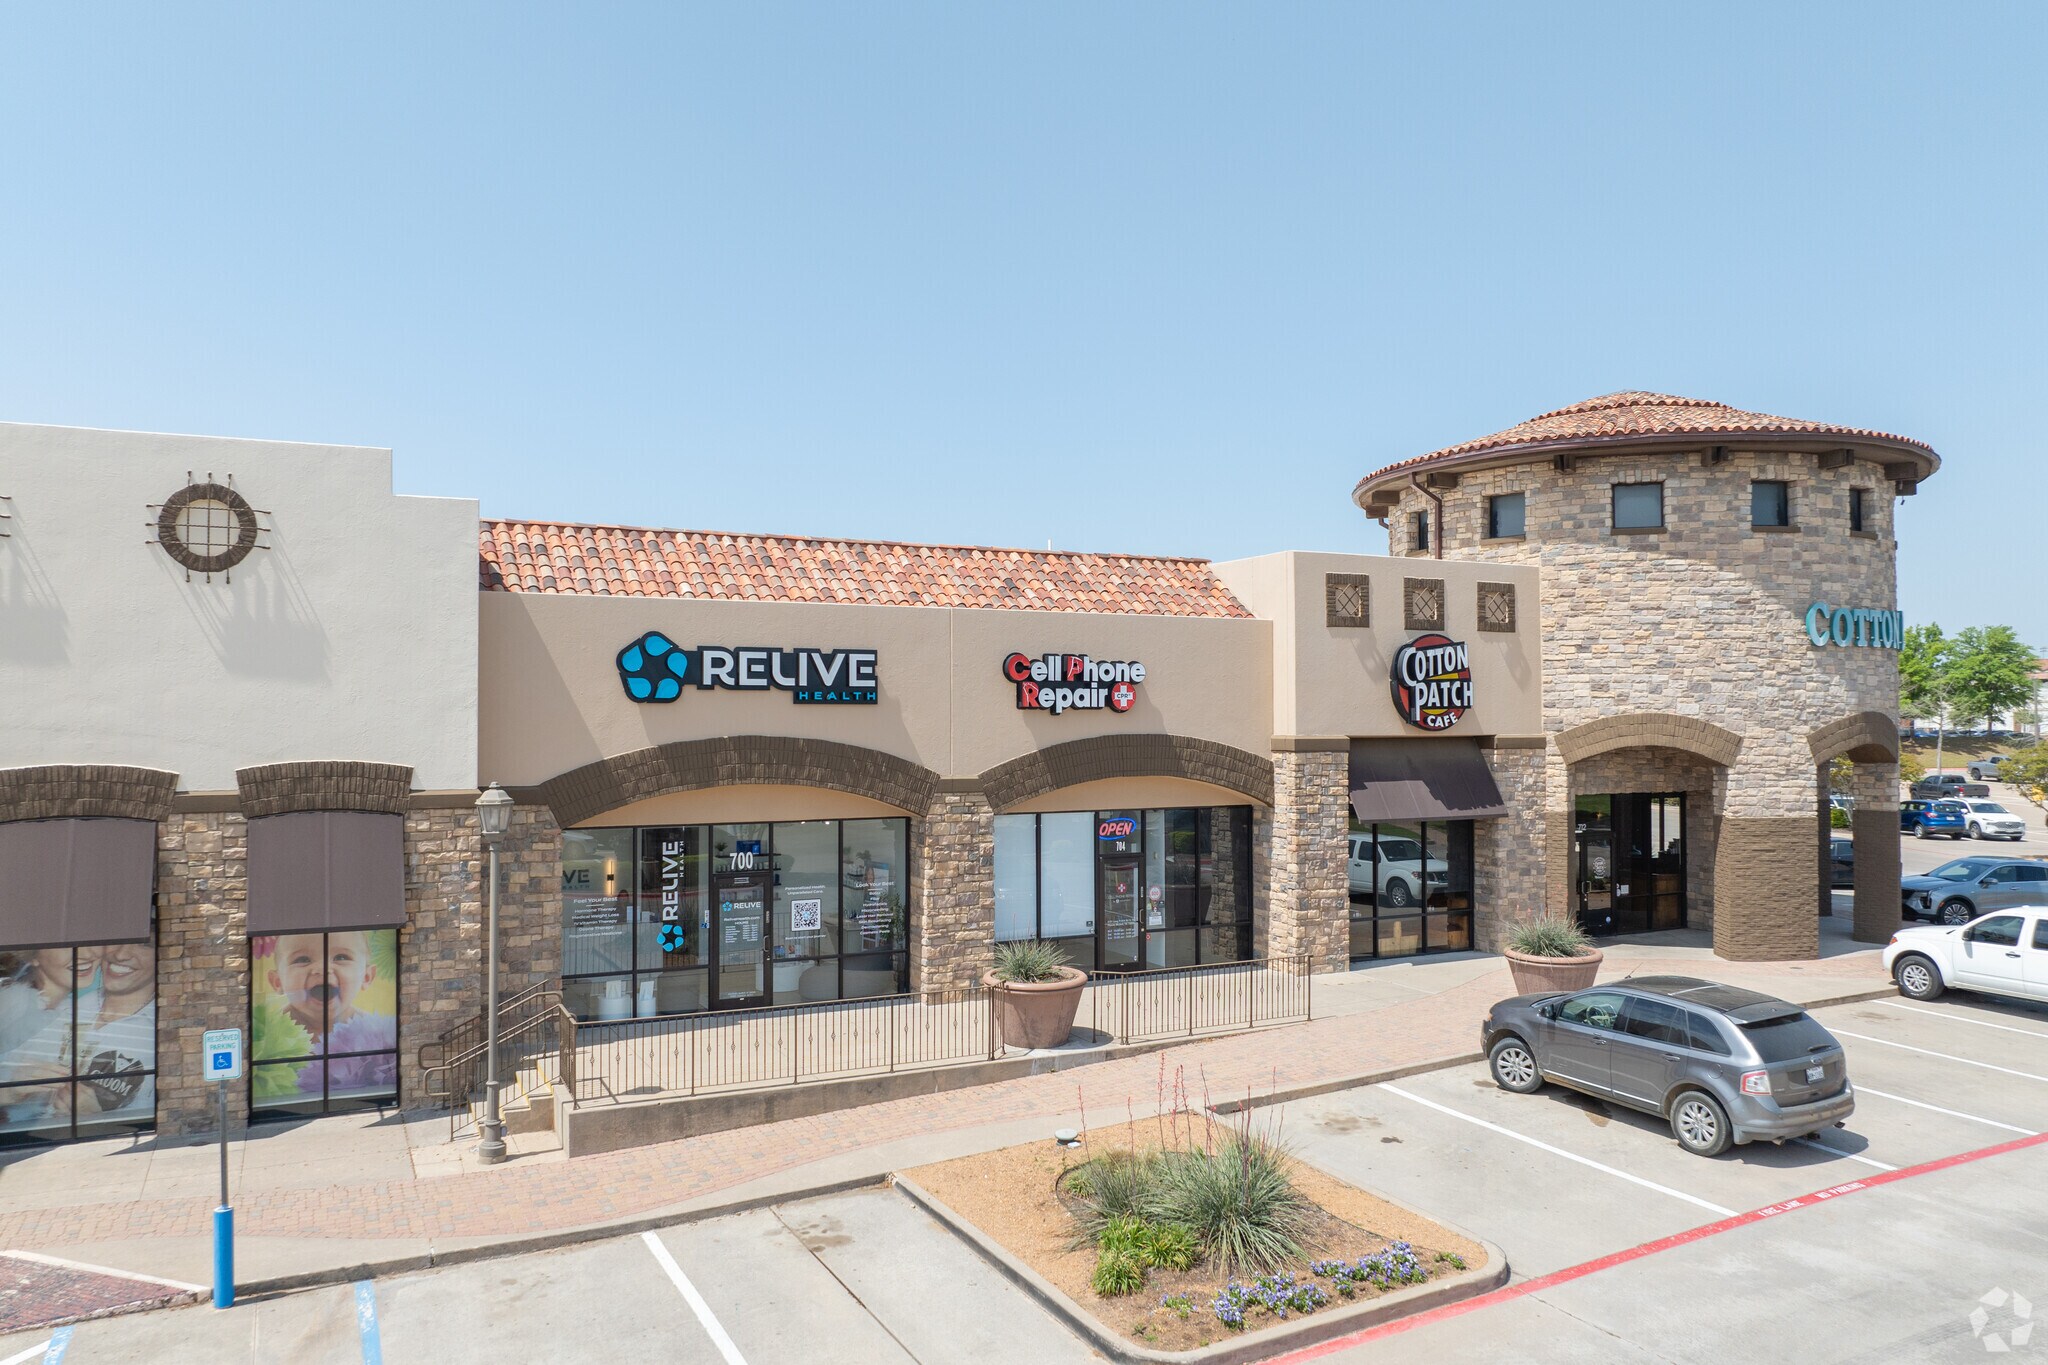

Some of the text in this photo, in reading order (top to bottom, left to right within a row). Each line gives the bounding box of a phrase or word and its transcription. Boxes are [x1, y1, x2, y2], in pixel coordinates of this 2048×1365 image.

[1806, 602, 1903, 650] COTTON
[703, 650, 876, 687] RELIVE
[1007, 652, 1146, 682] Cell Phone
[1402, 644, 1468, 686] COTTON
[799, 691, 876, 701] HEALTH
[1021, 682, 1108, 713] Repair
[1415, 681, 1473, 721] PATCH
[1427, 712, 1458, 727] CAFE
[1100, 821, 1133, 836] OPEN
[1116, 841, 1126, 852] 704
[729, 851, 754, 870] 700
[662, 841, 679, 920] RELIVE
[733, 901, 761, 909] RELIVE
[206, 1033, 240, 1042] RESERVED
[209, 1042, 236, 1051] PARKING
